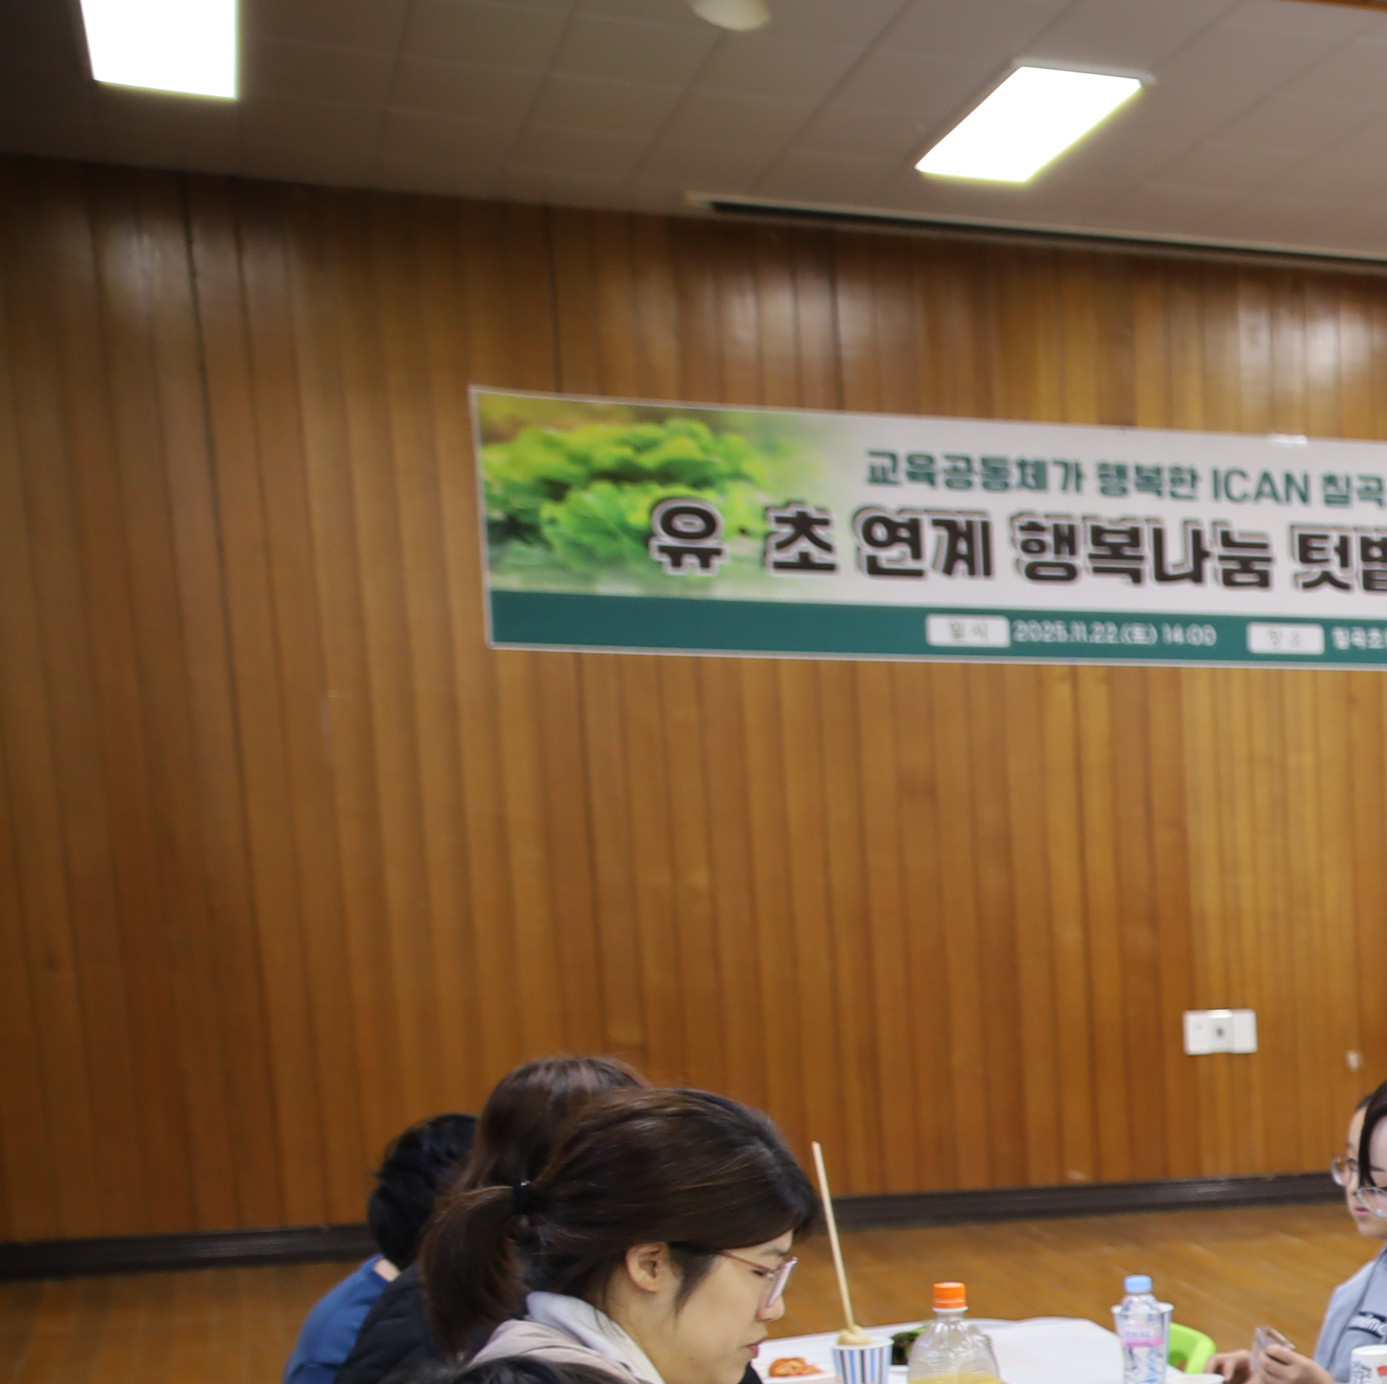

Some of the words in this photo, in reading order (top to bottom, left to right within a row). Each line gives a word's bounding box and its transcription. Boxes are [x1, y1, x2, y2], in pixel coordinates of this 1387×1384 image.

[865, 449, 1086, 493] 교육공동체가
[1094, 460, 1202, 501] 행복한
[1210, 467, 1311, 505] ICAN
[856, 507, 995, 581] 연계
[1012, 510, 1277, 590] 행복나눔
